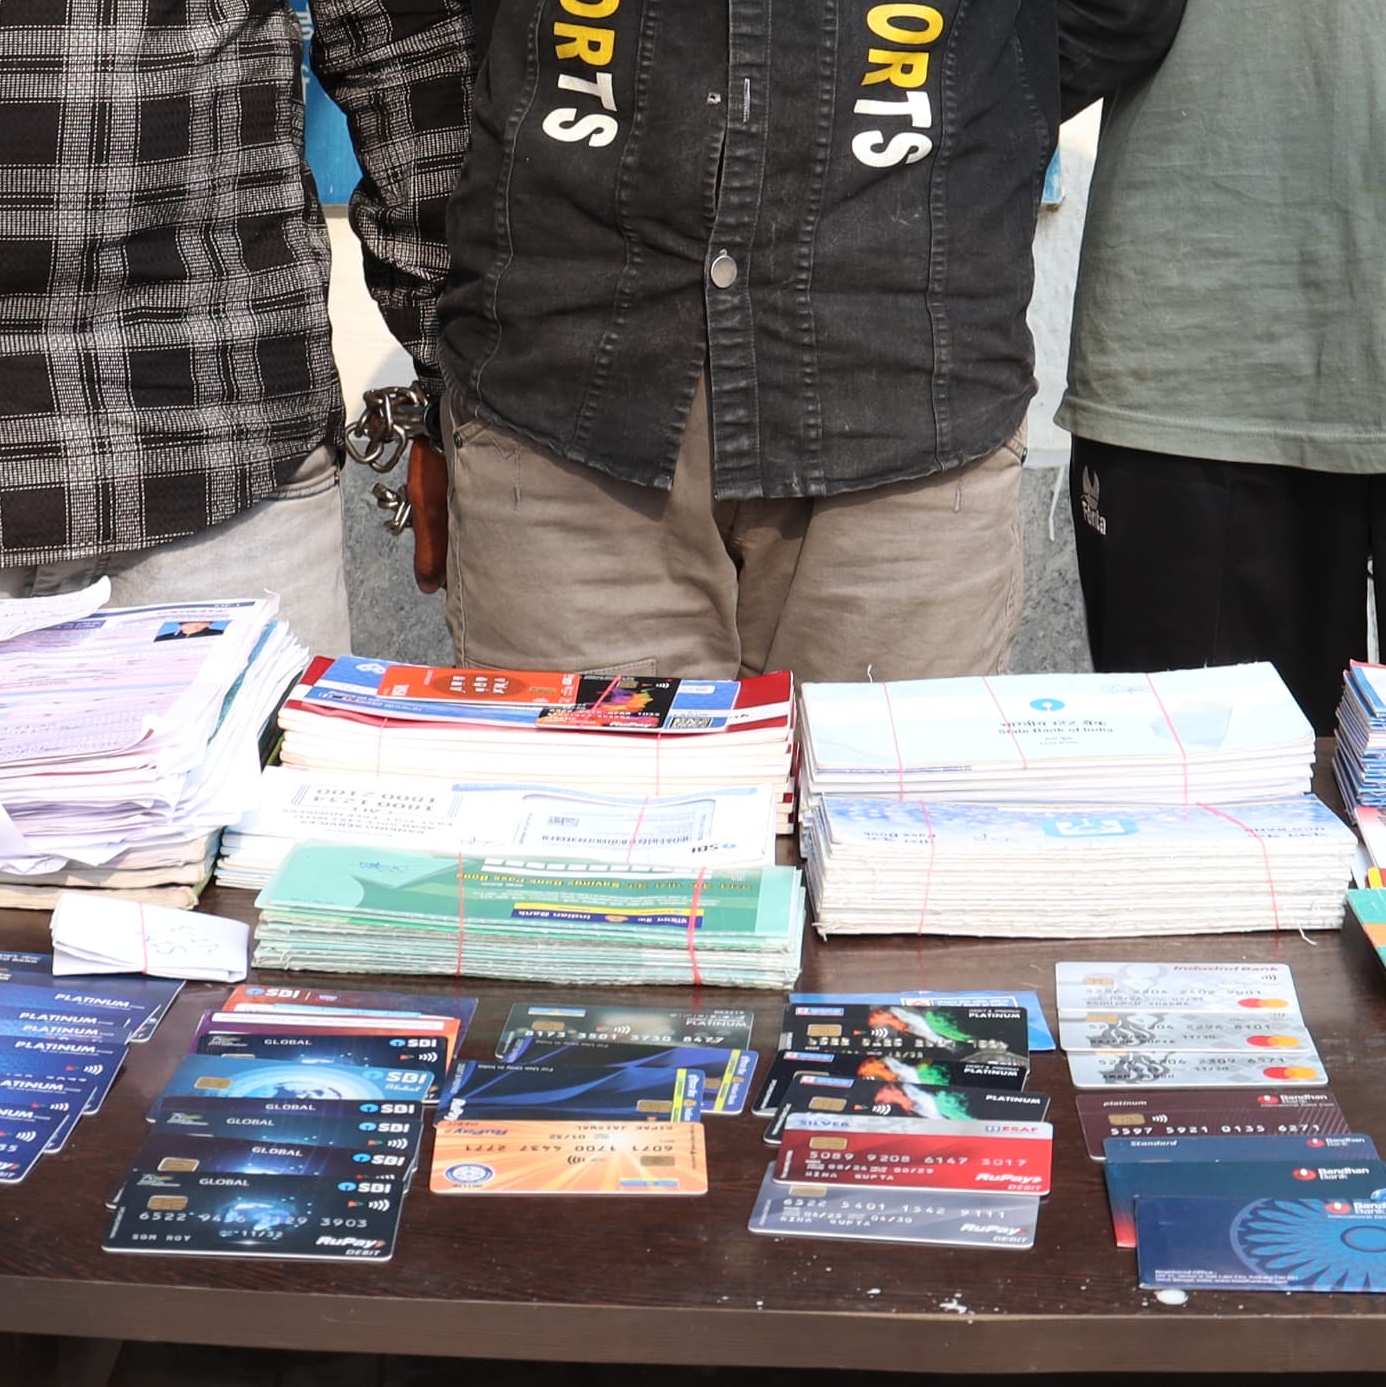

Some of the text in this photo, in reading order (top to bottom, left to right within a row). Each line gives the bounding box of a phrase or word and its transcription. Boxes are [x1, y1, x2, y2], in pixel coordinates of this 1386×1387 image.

[264, 988, 301, 1000] SBI
[55, 993, 131, 1009] PLATINUM
[15, 1041, 97, 1055] PLATINUM
[264, 1038, 313, 1046] GLOBAL
[406, 1038, 437, 1048] SBI
[385, 1071, 427, 1085] SBI
[985, 1094, 1042, 1104] PLATINUM
[265, 1103, 316, 1112] GLOBAL
[381, 1103, 415, 1115] SBI
[1130, 1138, 1178, 1148] Standard
[198, 1177, 251, 1187] GLOBAL
[357, 1181, 392, 1194] SBI
[315, 1236, 386, 1250] RuPay
